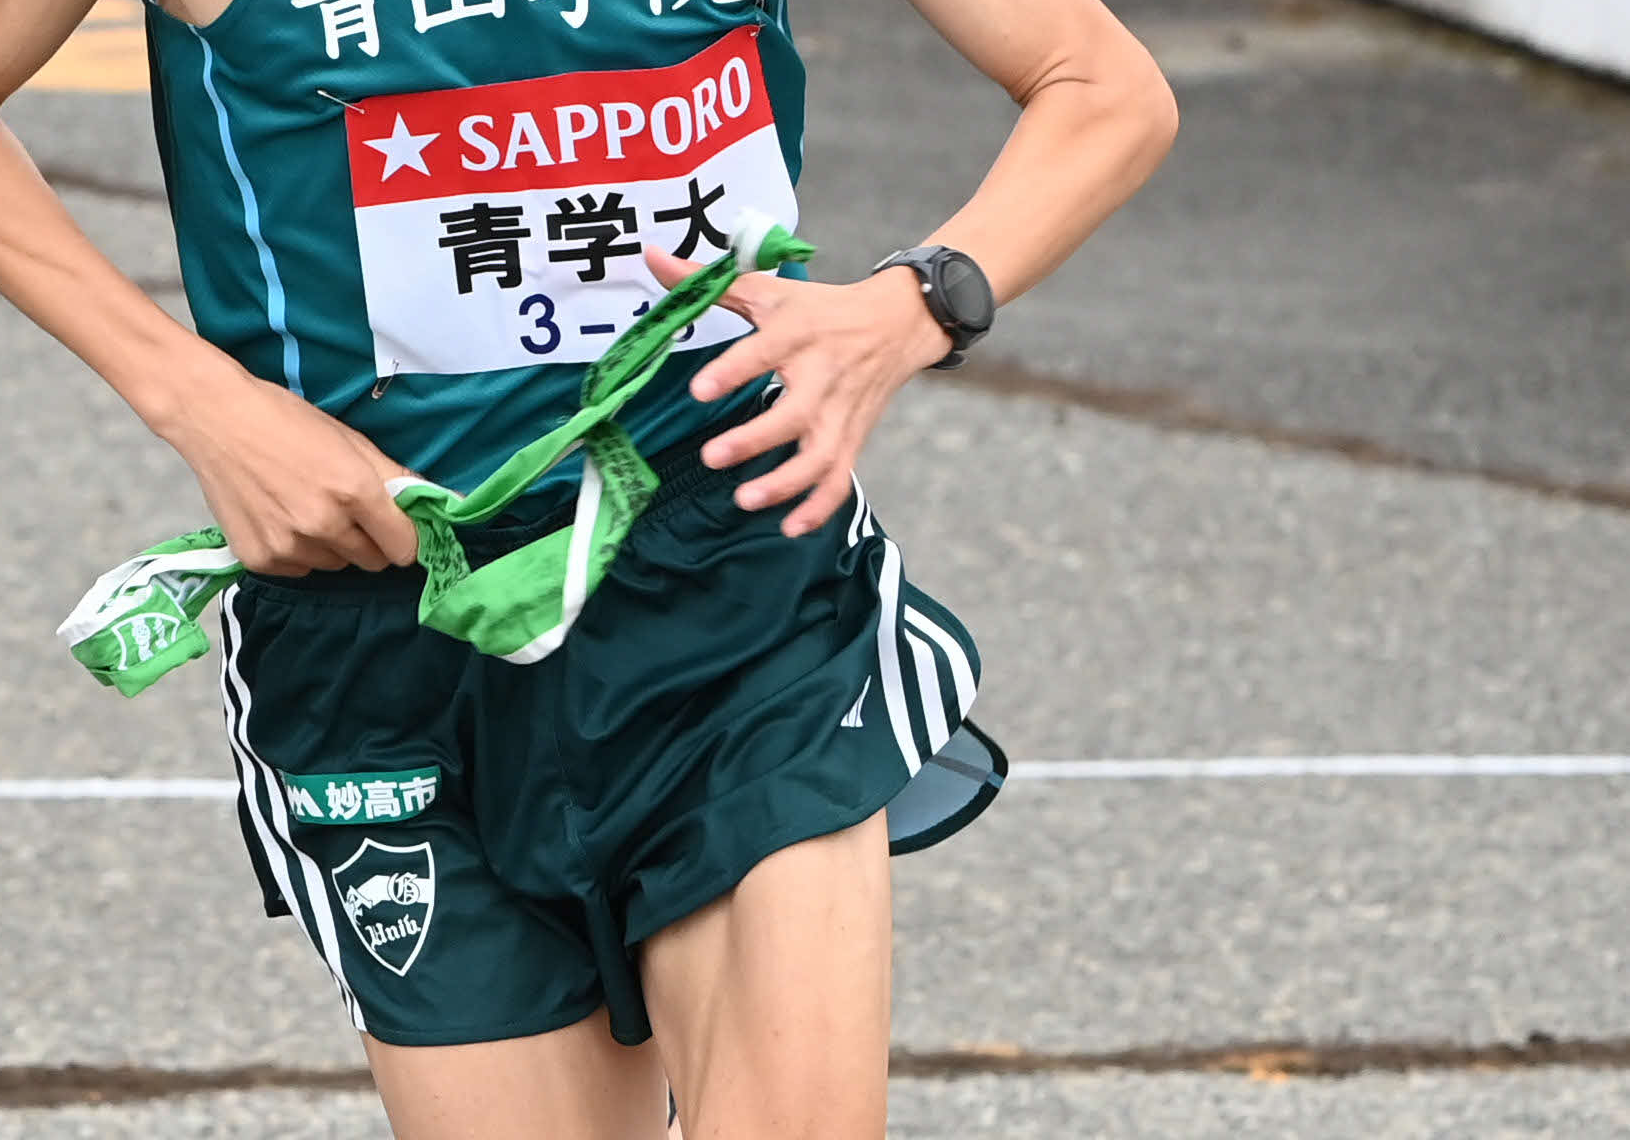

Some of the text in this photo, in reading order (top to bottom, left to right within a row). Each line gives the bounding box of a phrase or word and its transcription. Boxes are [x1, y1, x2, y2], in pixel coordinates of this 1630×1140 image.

[458, 56, 752, 172] SAPPORO
[438, 176, 730, 295] 青学大
[325, 776, 437, 820] 妙高市
